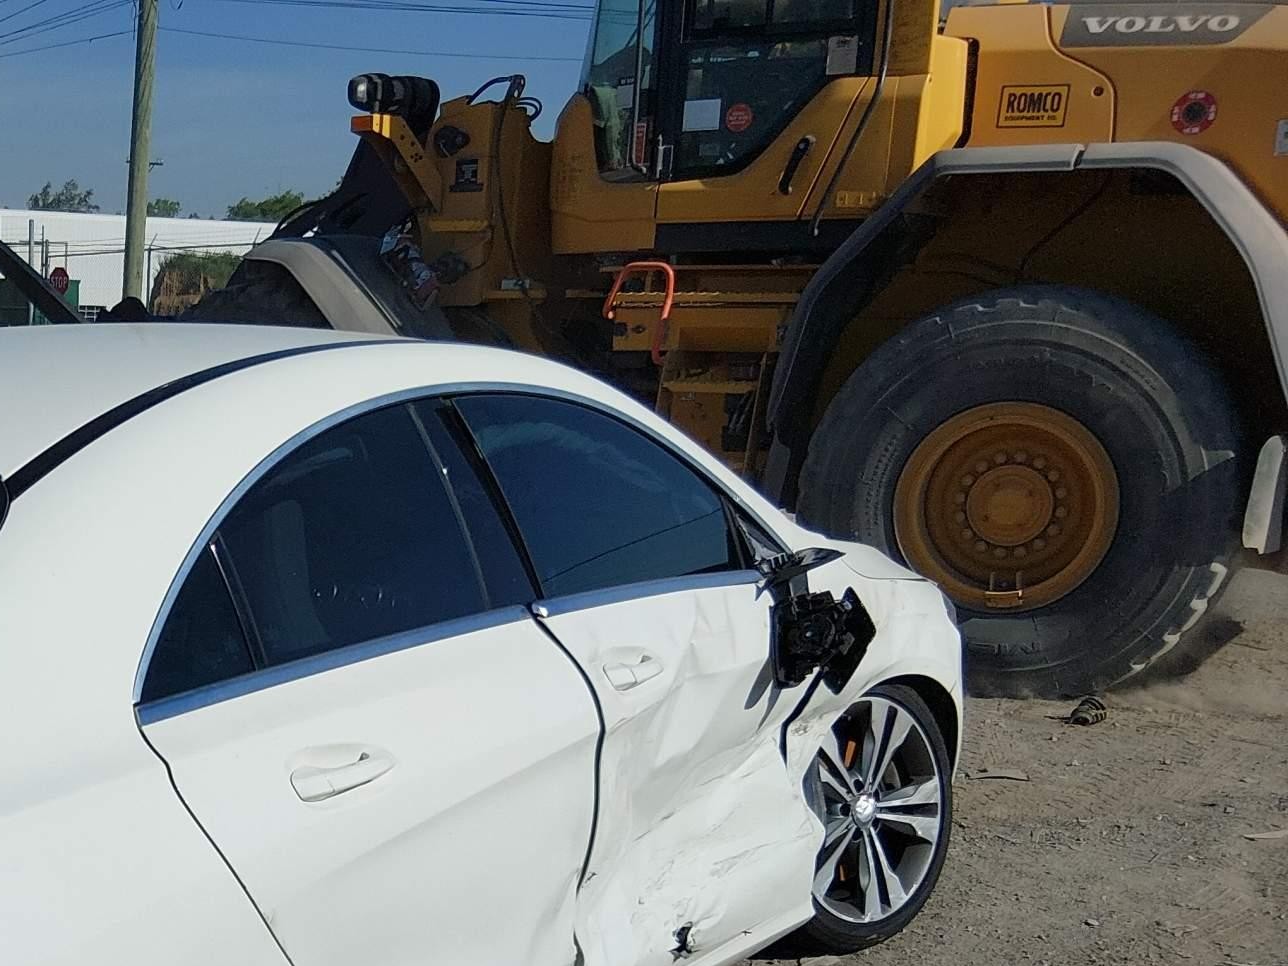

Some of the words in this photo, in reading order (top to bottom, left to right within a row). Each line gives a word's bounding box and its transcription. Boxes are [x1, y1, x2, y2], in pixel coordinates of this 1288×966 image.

[1081, 15, 1240, 33] VOLVO
[1006, 92, 1062, 113] ROMCO
[51, 276, 68, 288] STOP
